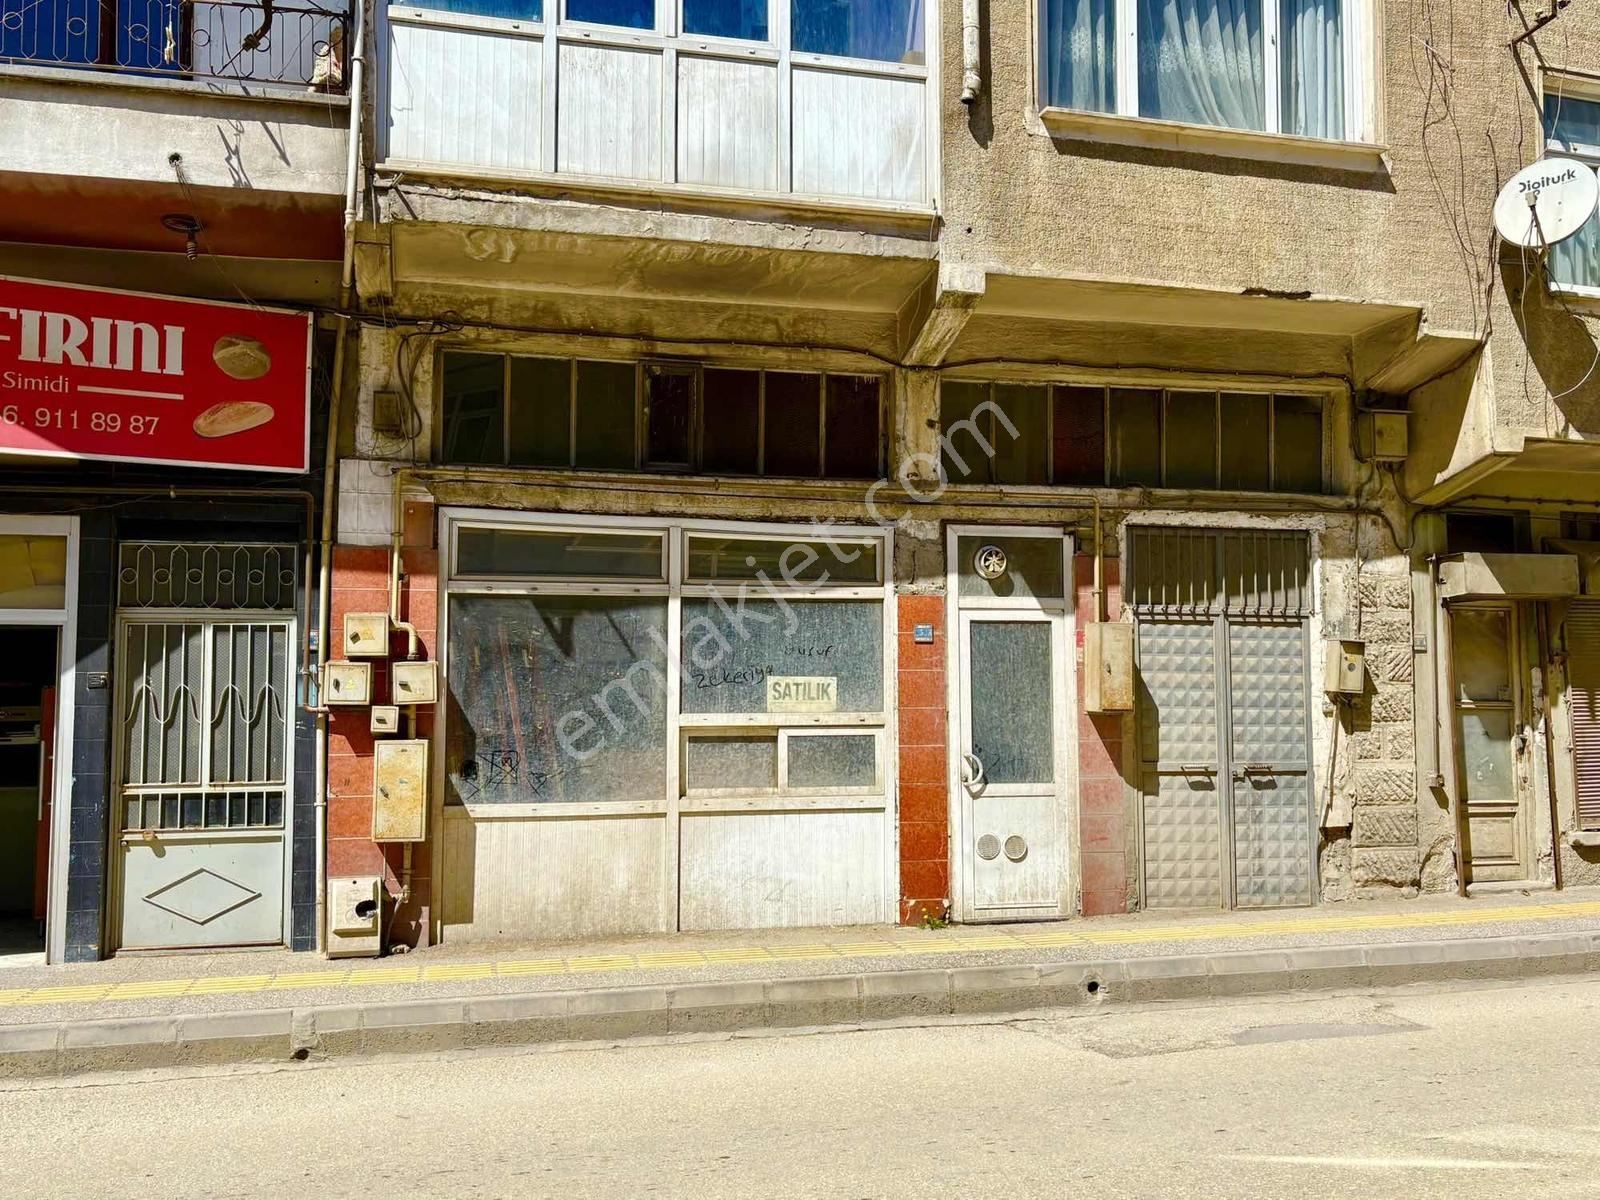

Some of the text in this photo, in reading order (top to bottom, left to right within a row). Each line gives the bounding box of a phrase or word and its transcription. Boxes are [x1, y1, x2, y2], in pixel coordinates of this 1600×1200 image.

[1518, 168, 1577, 196] Digiturk
[2, 371, 69, 393] Simidi
[35, 407, 79, 430] 911
[91, 411, 121, 433] 89
[129, 415, 160, 436] 87
[771, 681, 833, 701] SATILIK
